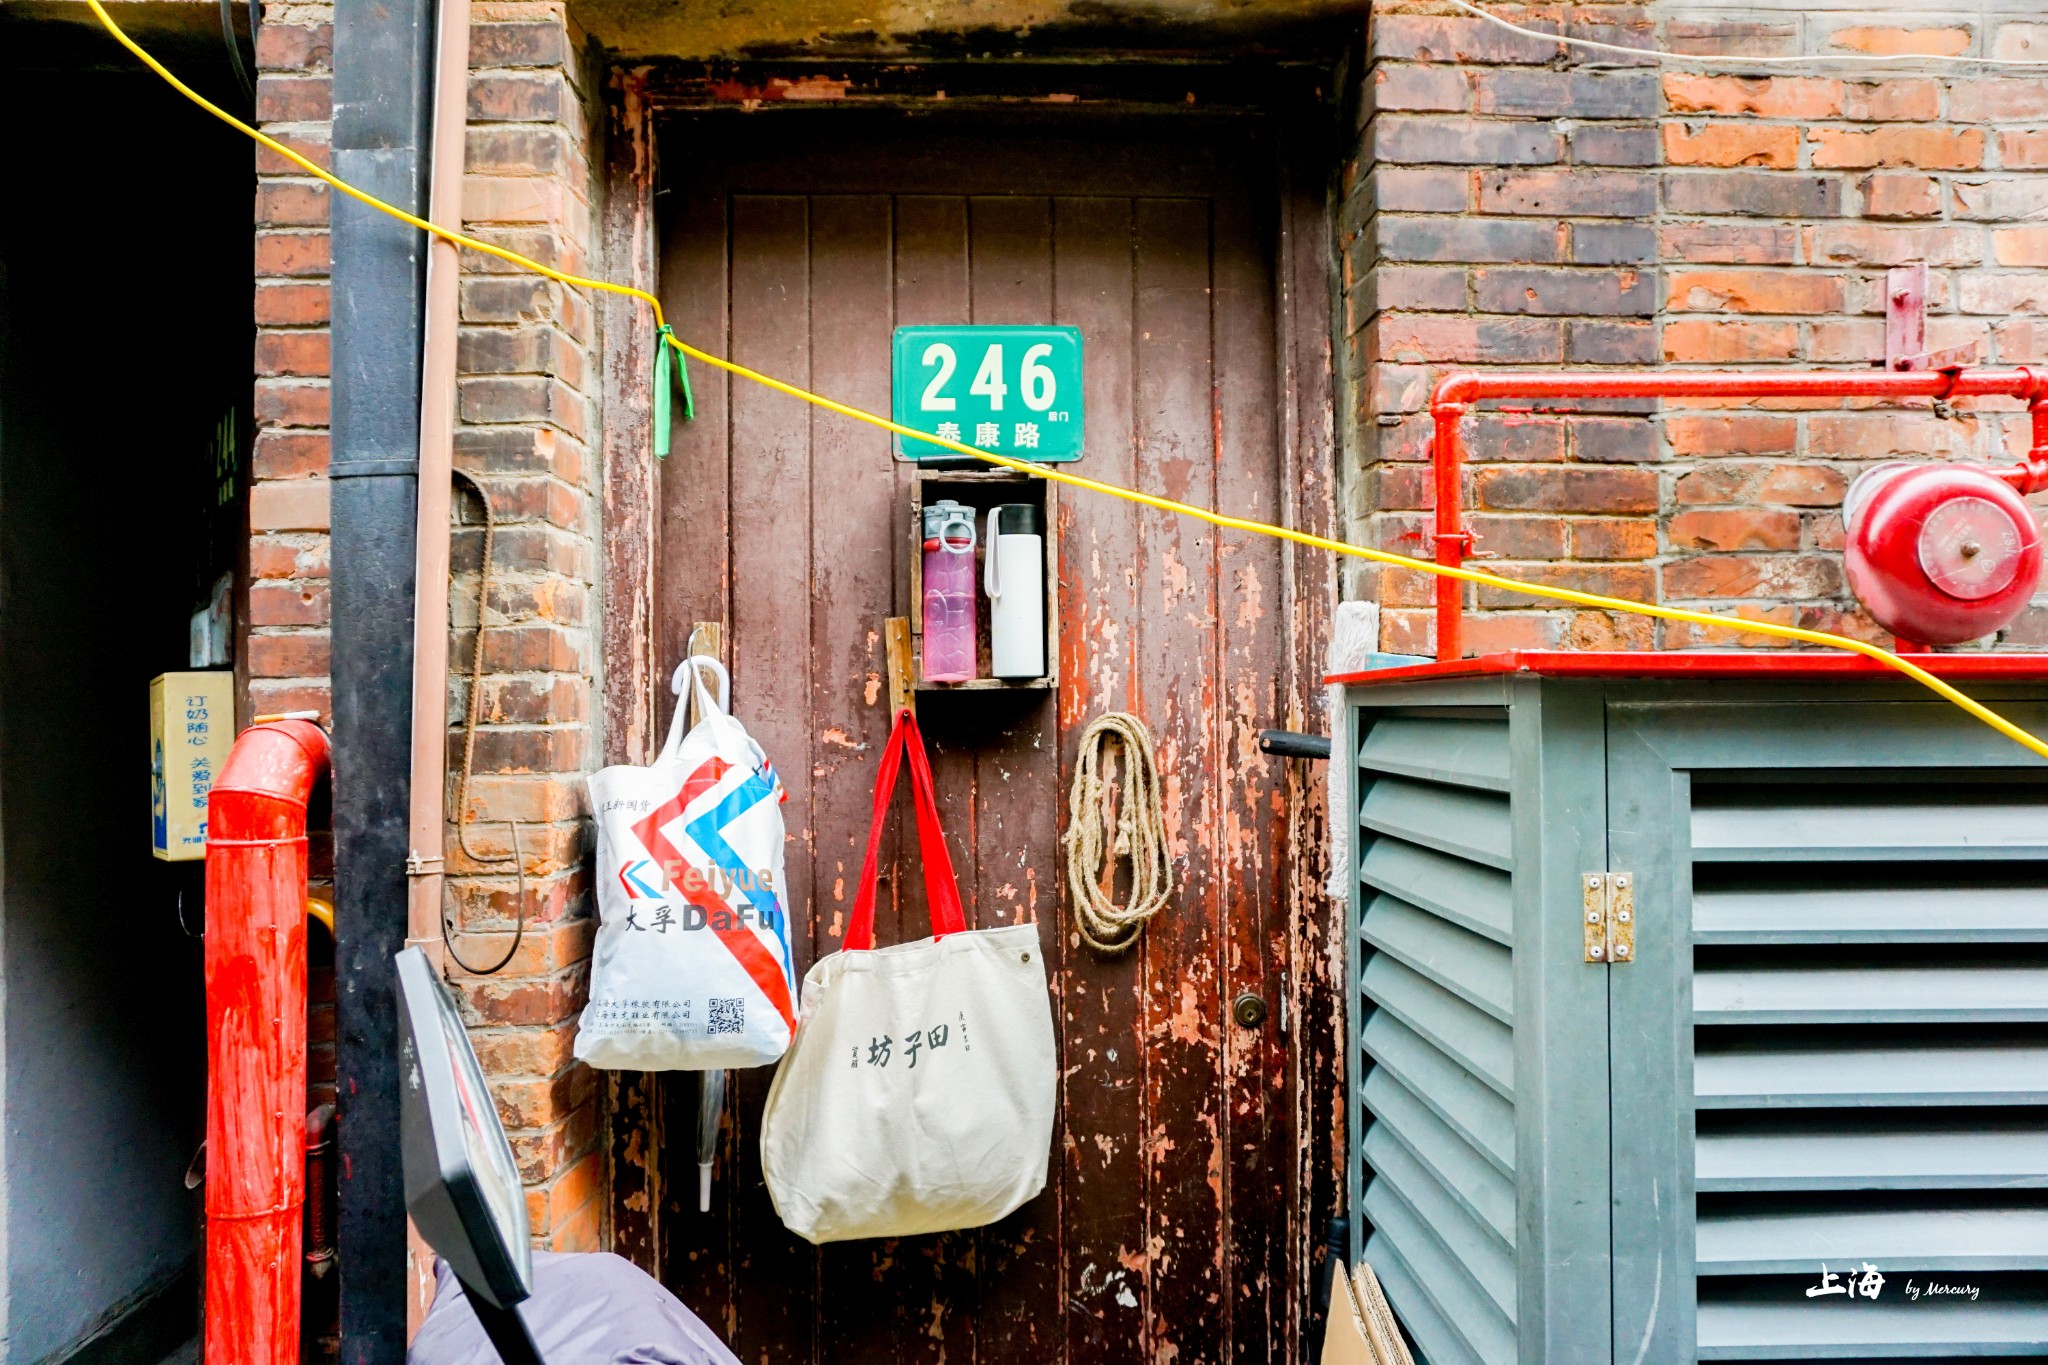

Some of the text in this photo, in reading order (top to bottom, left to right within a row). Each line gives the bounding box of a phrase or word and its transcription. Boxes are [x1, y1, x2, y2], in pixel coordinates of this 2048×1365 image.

[920, 342, 1057, 412] 246
[1047, 411, 1069, 422] 后门
[935, 421, 1041, 449] 泰康路
[186, 695, 209, 746] 订奶随心
[661, 858, 773, 901] Feiyue
[625, 904, 676, 934] 大孚
[682, 903, 774, 932] DaFu
